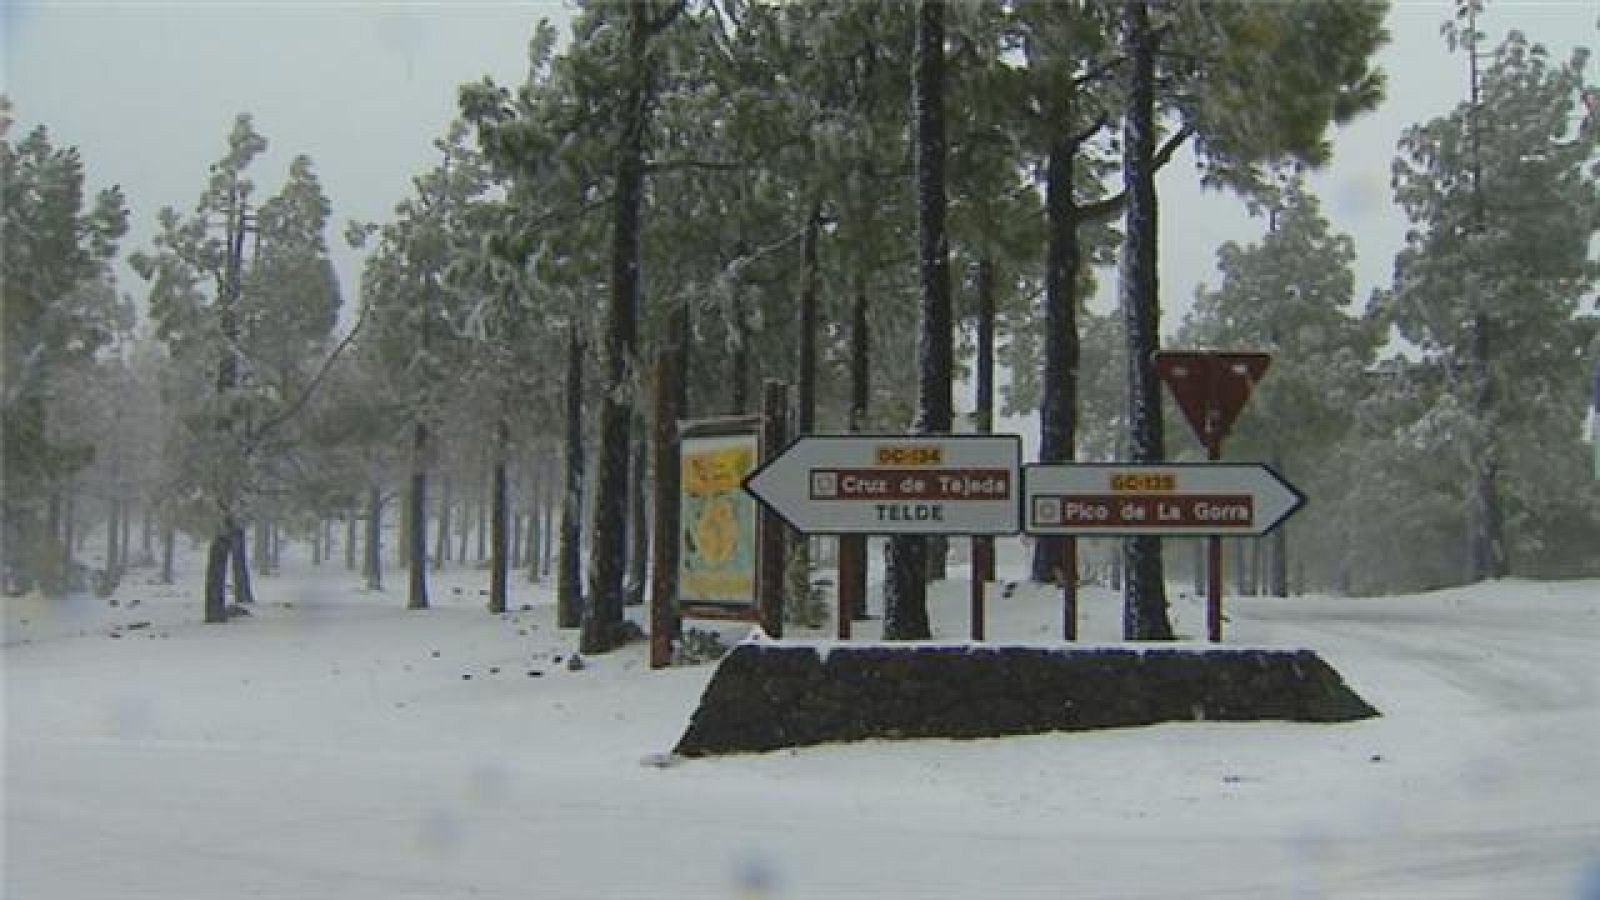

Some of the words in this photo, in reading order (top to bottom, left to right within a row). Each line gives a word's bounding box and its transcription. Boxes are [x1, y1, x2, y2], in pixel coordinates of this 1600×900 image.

[841, 476, 888, 493] Cruz
[900, 476, 926, 493] de
[939, 476, 1006, 496] Tejeda
[875, 504, 944, 521] TELDE
[1065, 502, 1108, 520] Pico
[1120, 502, 1146, 520] de
[1158, 502, 1181, 520] La
[1194, 502, 1250, 520] Gorra
